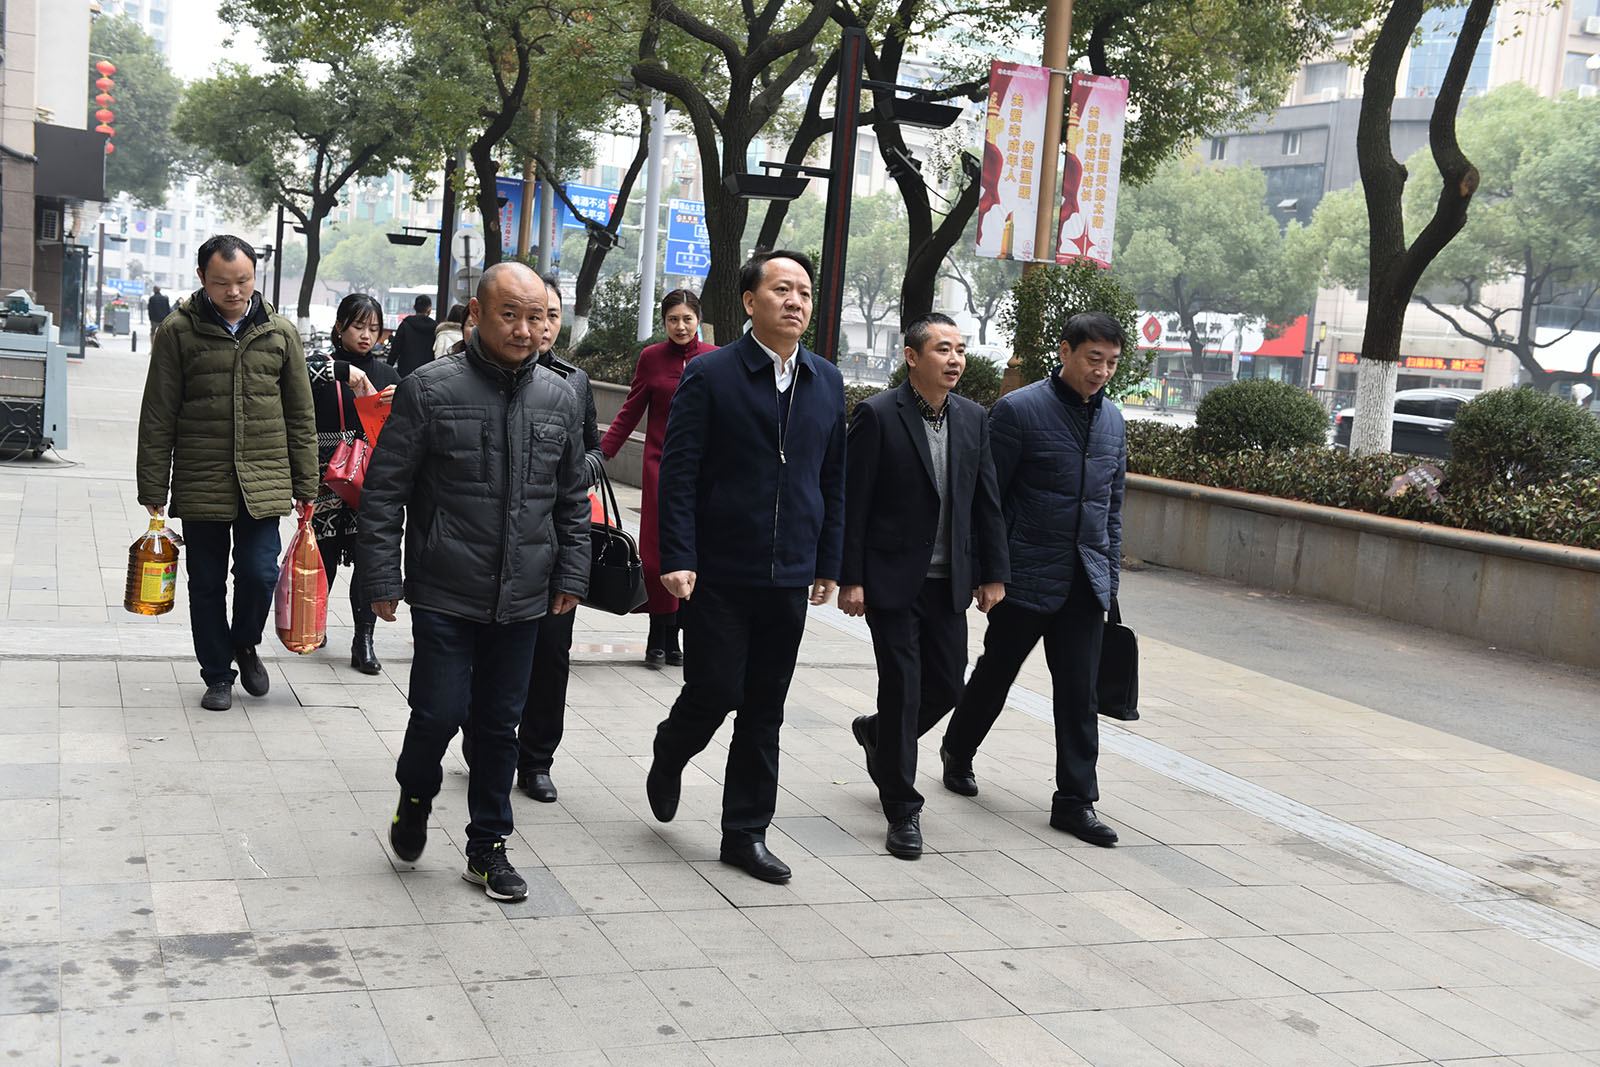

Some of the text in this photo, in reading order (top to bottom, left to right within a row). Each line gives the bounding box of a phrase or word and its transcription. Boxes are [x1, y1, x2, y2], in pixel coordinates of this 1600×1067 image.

[1004, 94, 1024, 183] 关爱未成年人
[571, 194, 607, 210] 滴酒不沾
